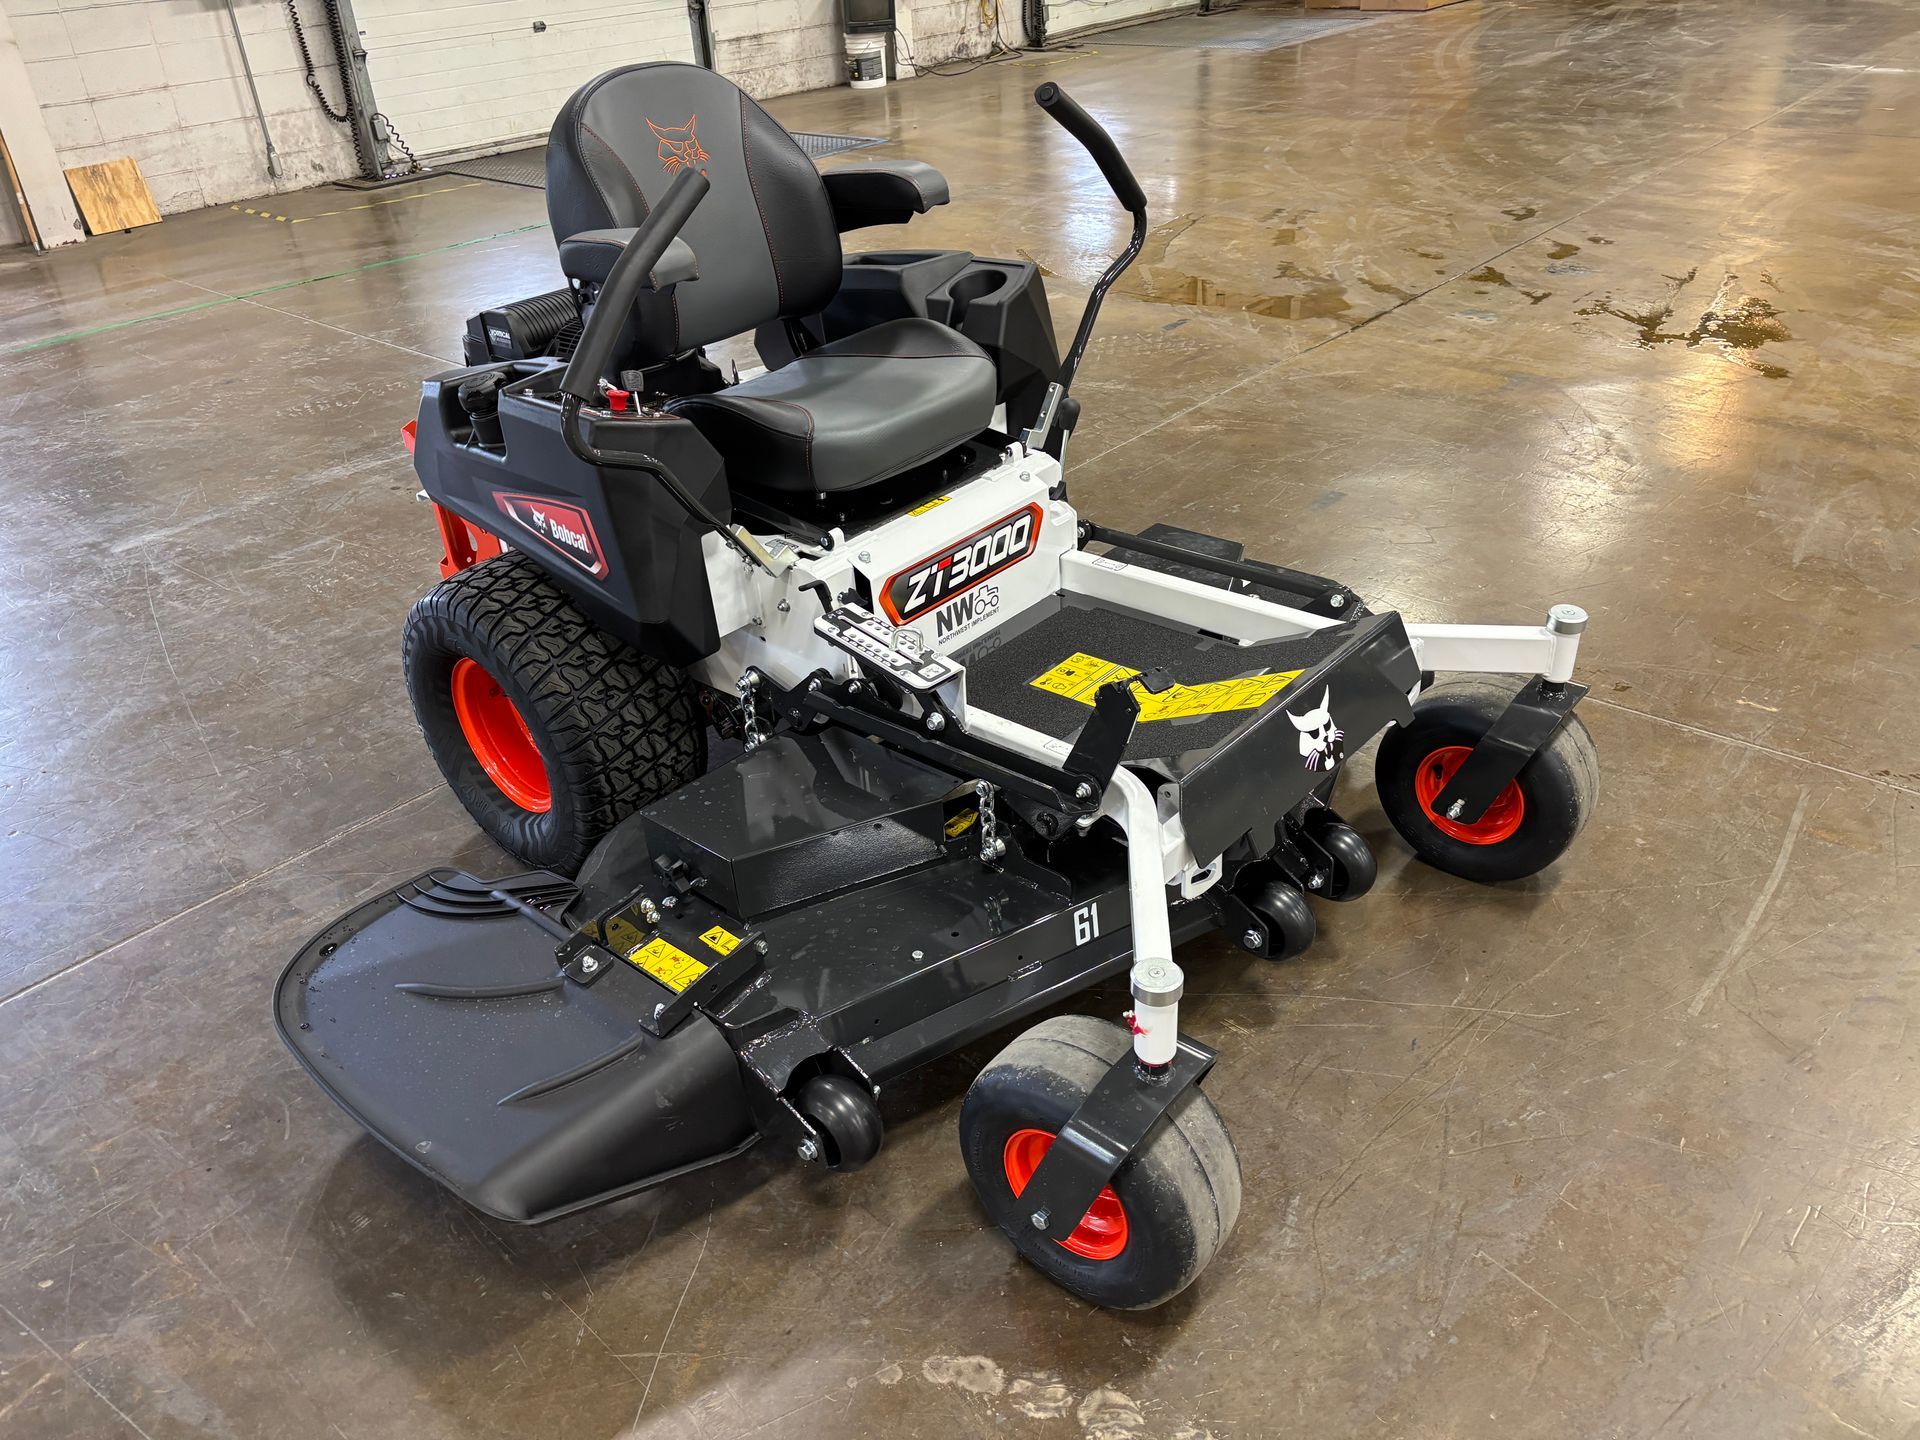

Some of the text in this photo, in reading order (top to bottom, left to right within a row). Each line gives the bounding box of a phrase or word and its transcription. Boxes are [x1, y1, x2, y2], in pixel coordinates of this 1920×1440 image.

[549, 518, 590, 554] Bobcat
[936, 592, 974, 638] NW
[938, 623, 971, 646] NORTHWEST
[971, 606, 1000, 627] IMPLEMENT
[1073, 902, 1100, 947] 61
